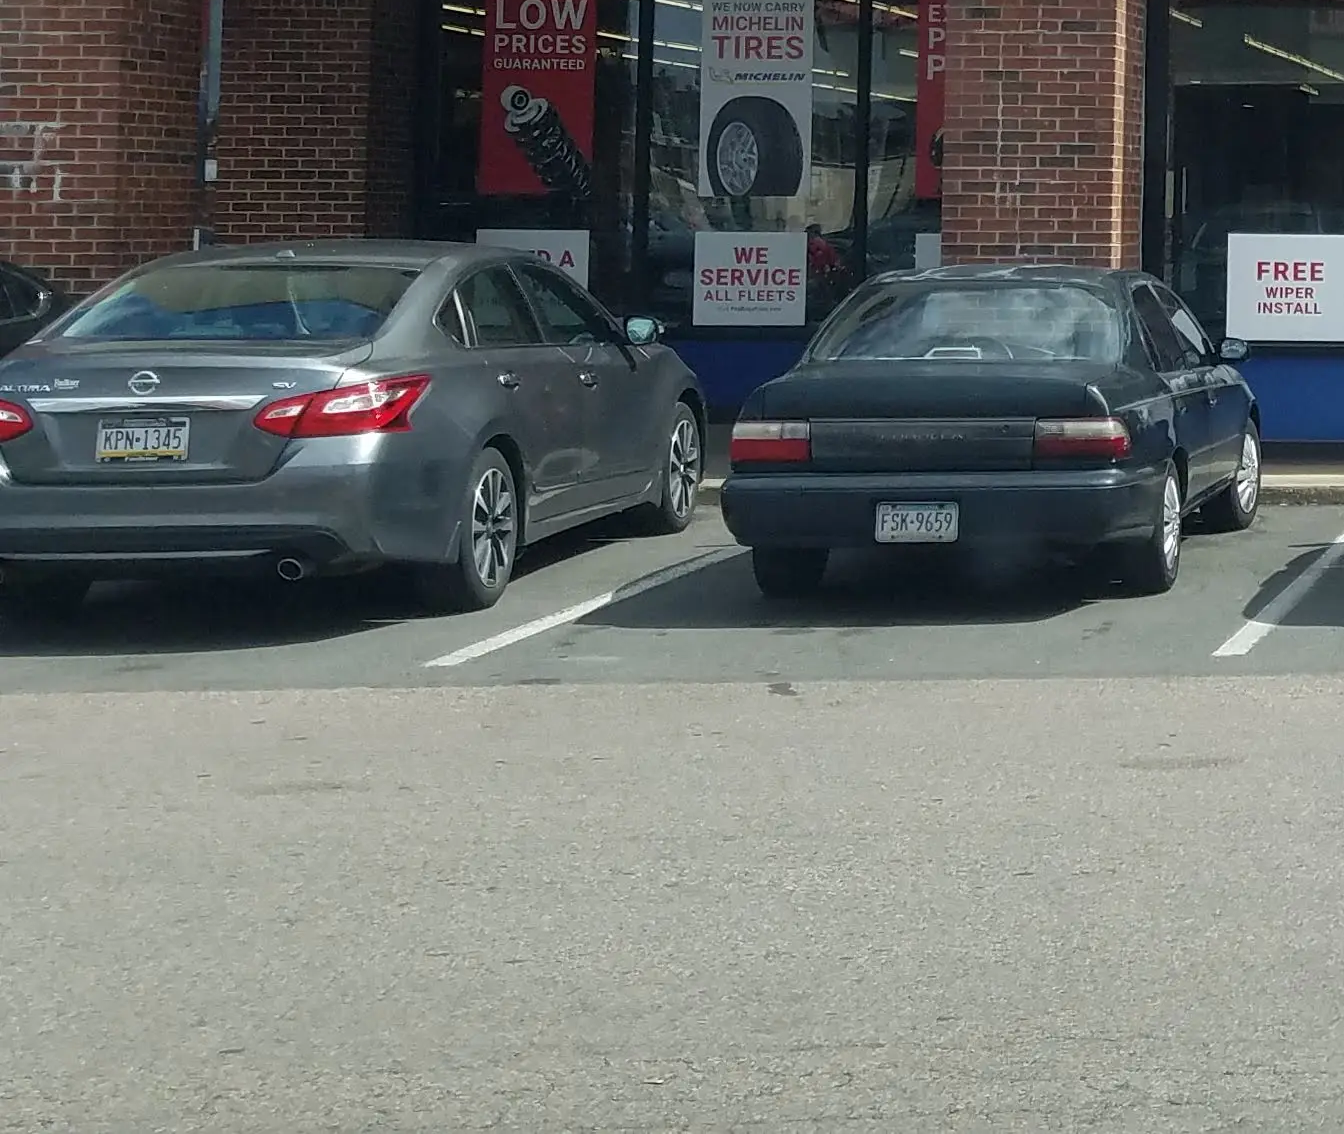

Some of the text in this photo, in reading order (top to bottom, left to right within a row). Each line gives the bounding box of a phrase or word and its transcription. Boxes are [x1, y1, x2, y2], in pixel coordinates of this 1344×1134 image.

[712, 2, 806, 12] WE NOW CARRY
[712, 16, 804, 31] MICHELIN
[494, 33, 587, 54] PRICES
[711, 35, 805, 60] TIRES
[493, 58, 585, 70] GUARANTEED
[734, 72, 806, 82] MICHELIN
[559, 250, 575, 267] A
[734, 247, 769, 265] WE
[700, 268, 801, 286] SERVICE
[1257, 261, 1324, 282] FREE
[703, 290, 796, 302] ALL FLEETS
[1265, 287, 1314, 299] WIPER
[1257, 302, 1322, 315] INSTALL
[272, 382, 297, 390] SV
